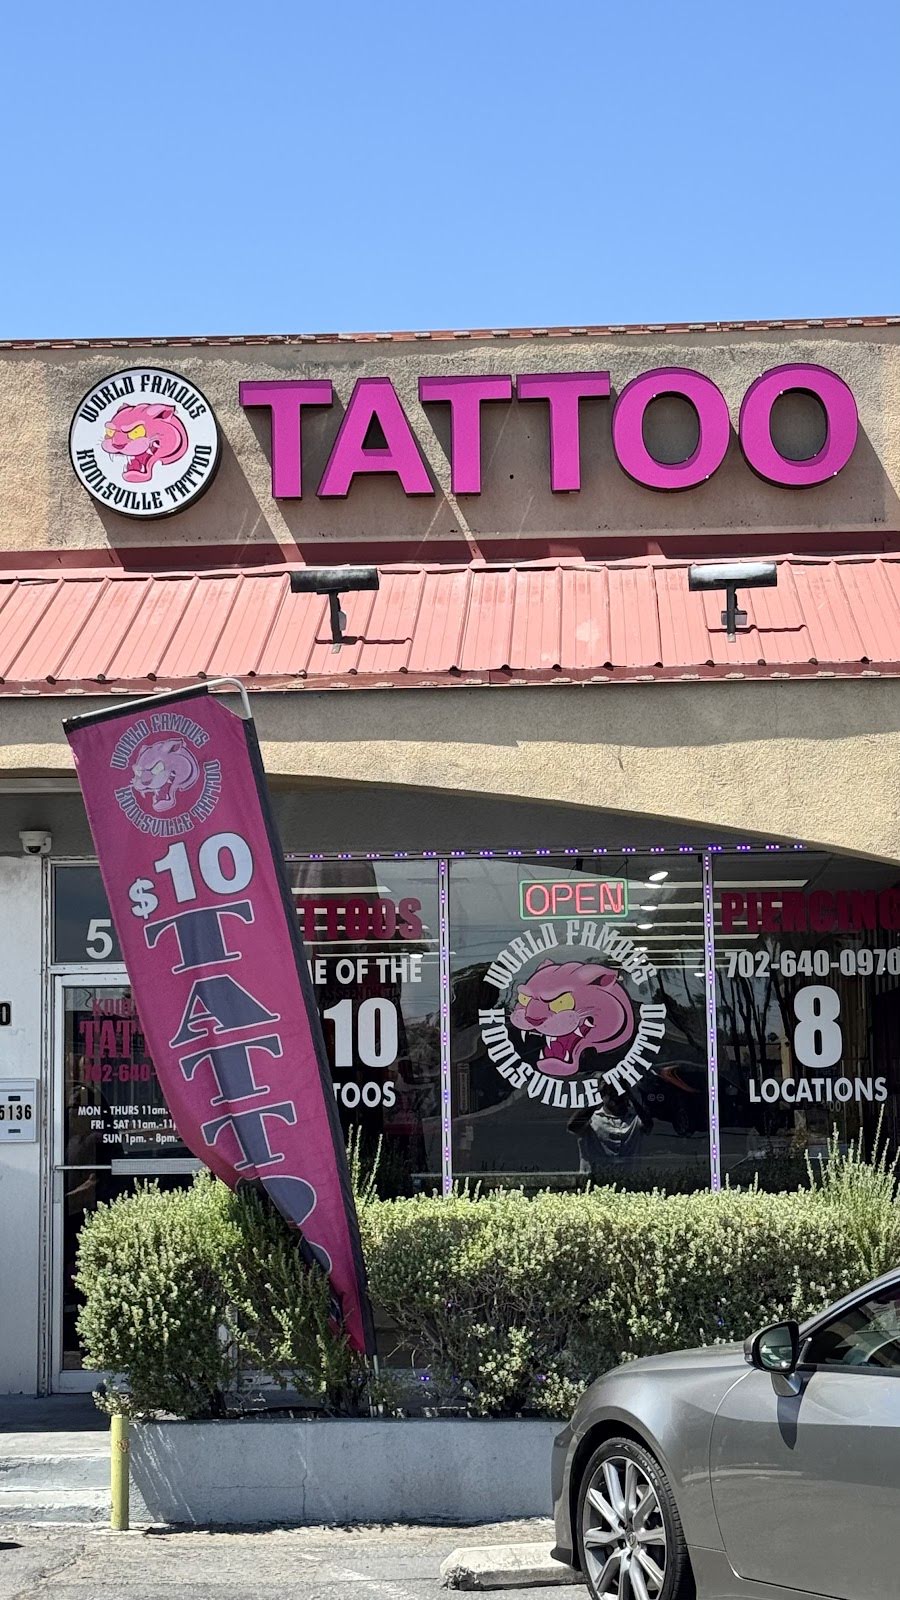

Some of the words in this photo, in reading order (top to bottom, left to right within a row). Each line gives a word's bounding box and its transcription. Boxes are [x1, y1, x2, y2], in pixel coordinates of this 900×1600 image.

[79, 375, 136, 424] WORLD
[139, 374, 207, 421] FAMOUS
[239, 362, 858, 500] TATTOO
[77, 448, 164, 510] KOOLSVILLE
[164, 444, 212, 504] TATTOO
[110, 718, 151, 771] WORLD
[151, 712, 211, 749] FAMOUS
[114, 784, 195, 837] KOOLSVILLE
[190, 758, 222, 823] TATTOO
[128, 831, 254, 919] $10
[525, 882, 625, 916] OPEN
[720, 888, 900, 933] PIERCING
[335, 959, 368, 985] OF
[376, 958, 422, 984] THE
[482, 922, 560, 990] WORLD
[565, 919, 658, 986] FAMOUS
[725, 948, 900, 978] 702-640-0970
[793, 985, 843, 1068] 8
[478, 1008, 603, 1109] KOOLSVILLE
[603, 1003, 667, 1096] TATTOO
[78, 1106, 101, 1116] MON
[110, 1105, 139, 1116] THURS
[749, 1077, 888, 1103] LOCATIONS
[91, 1120, 106, 1130] FRI
[113, 1119, 130, 1130] SAT
[103, 1133, 121, 1144] SUN
[124, 1133, 147, 1145] 1pm.
